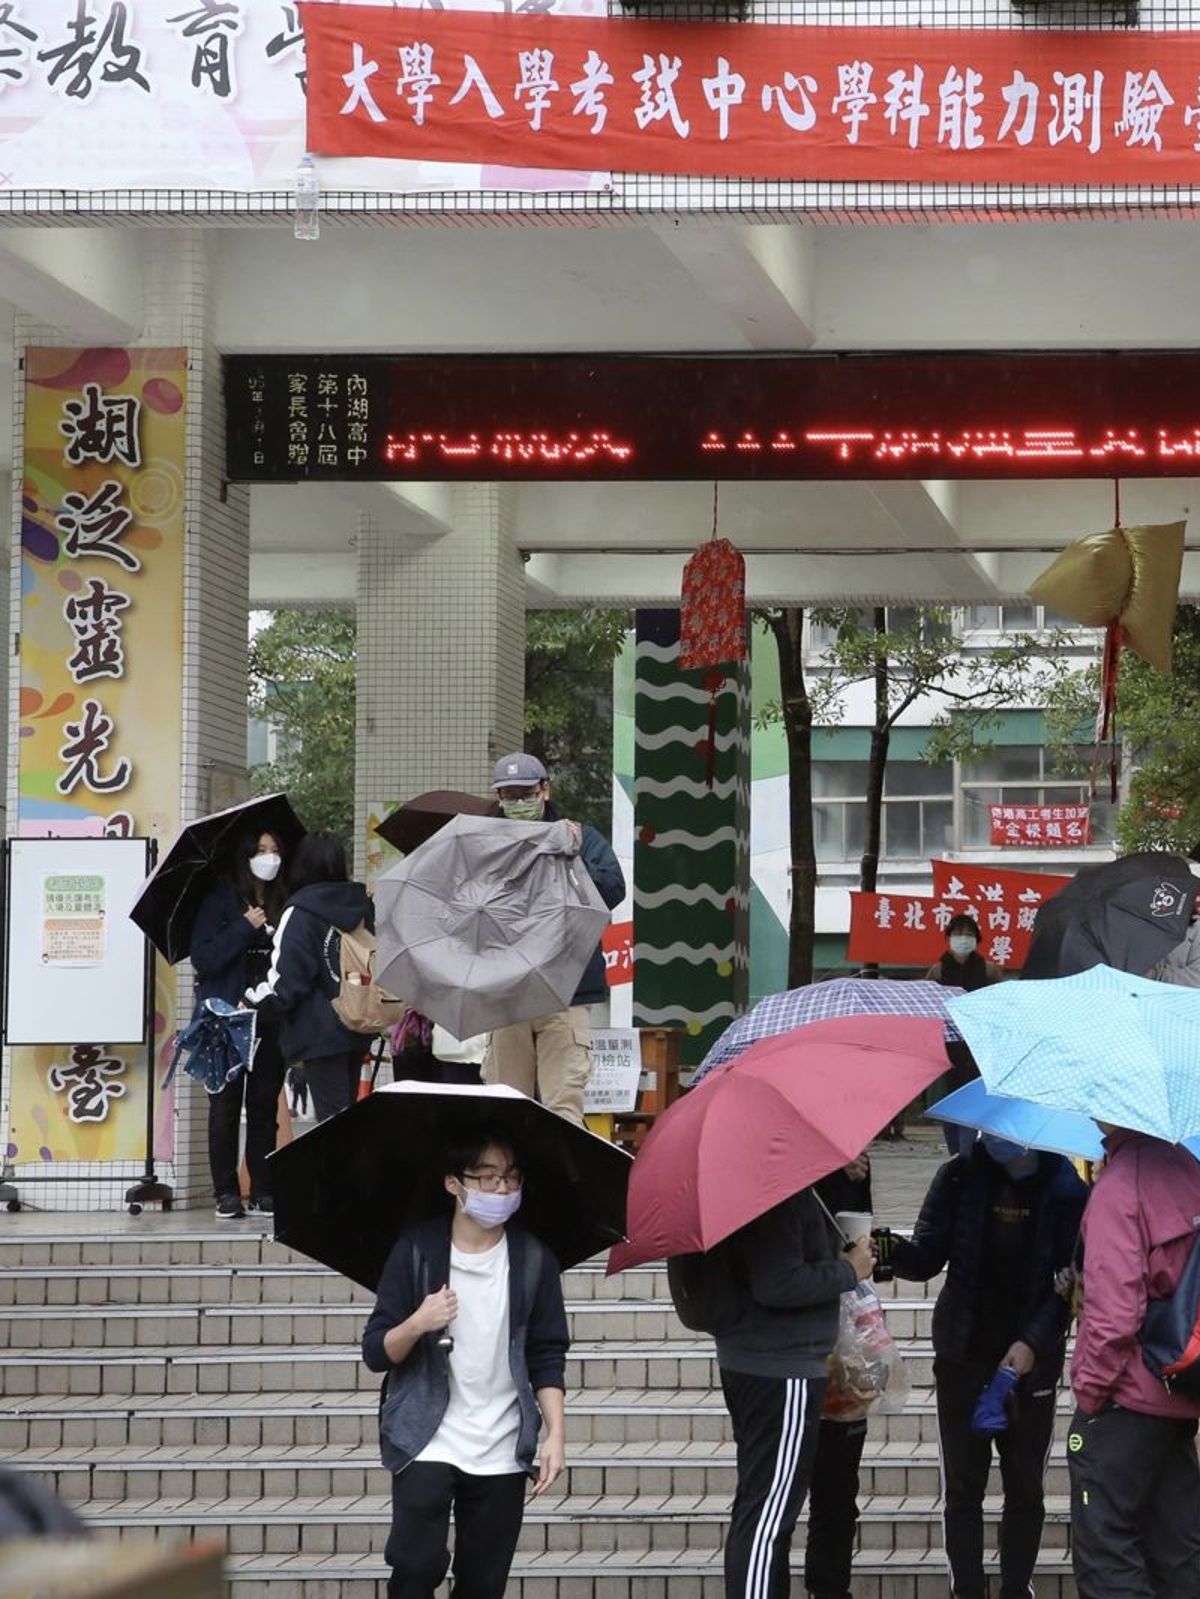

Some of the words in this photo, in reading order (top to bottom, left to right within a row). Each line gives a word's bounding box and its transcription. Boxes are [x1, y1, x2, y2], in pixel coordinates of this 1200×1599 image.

[317, 373, 339, 466] 第十八屆
[347, 373, 369, 467] 內湖高中
